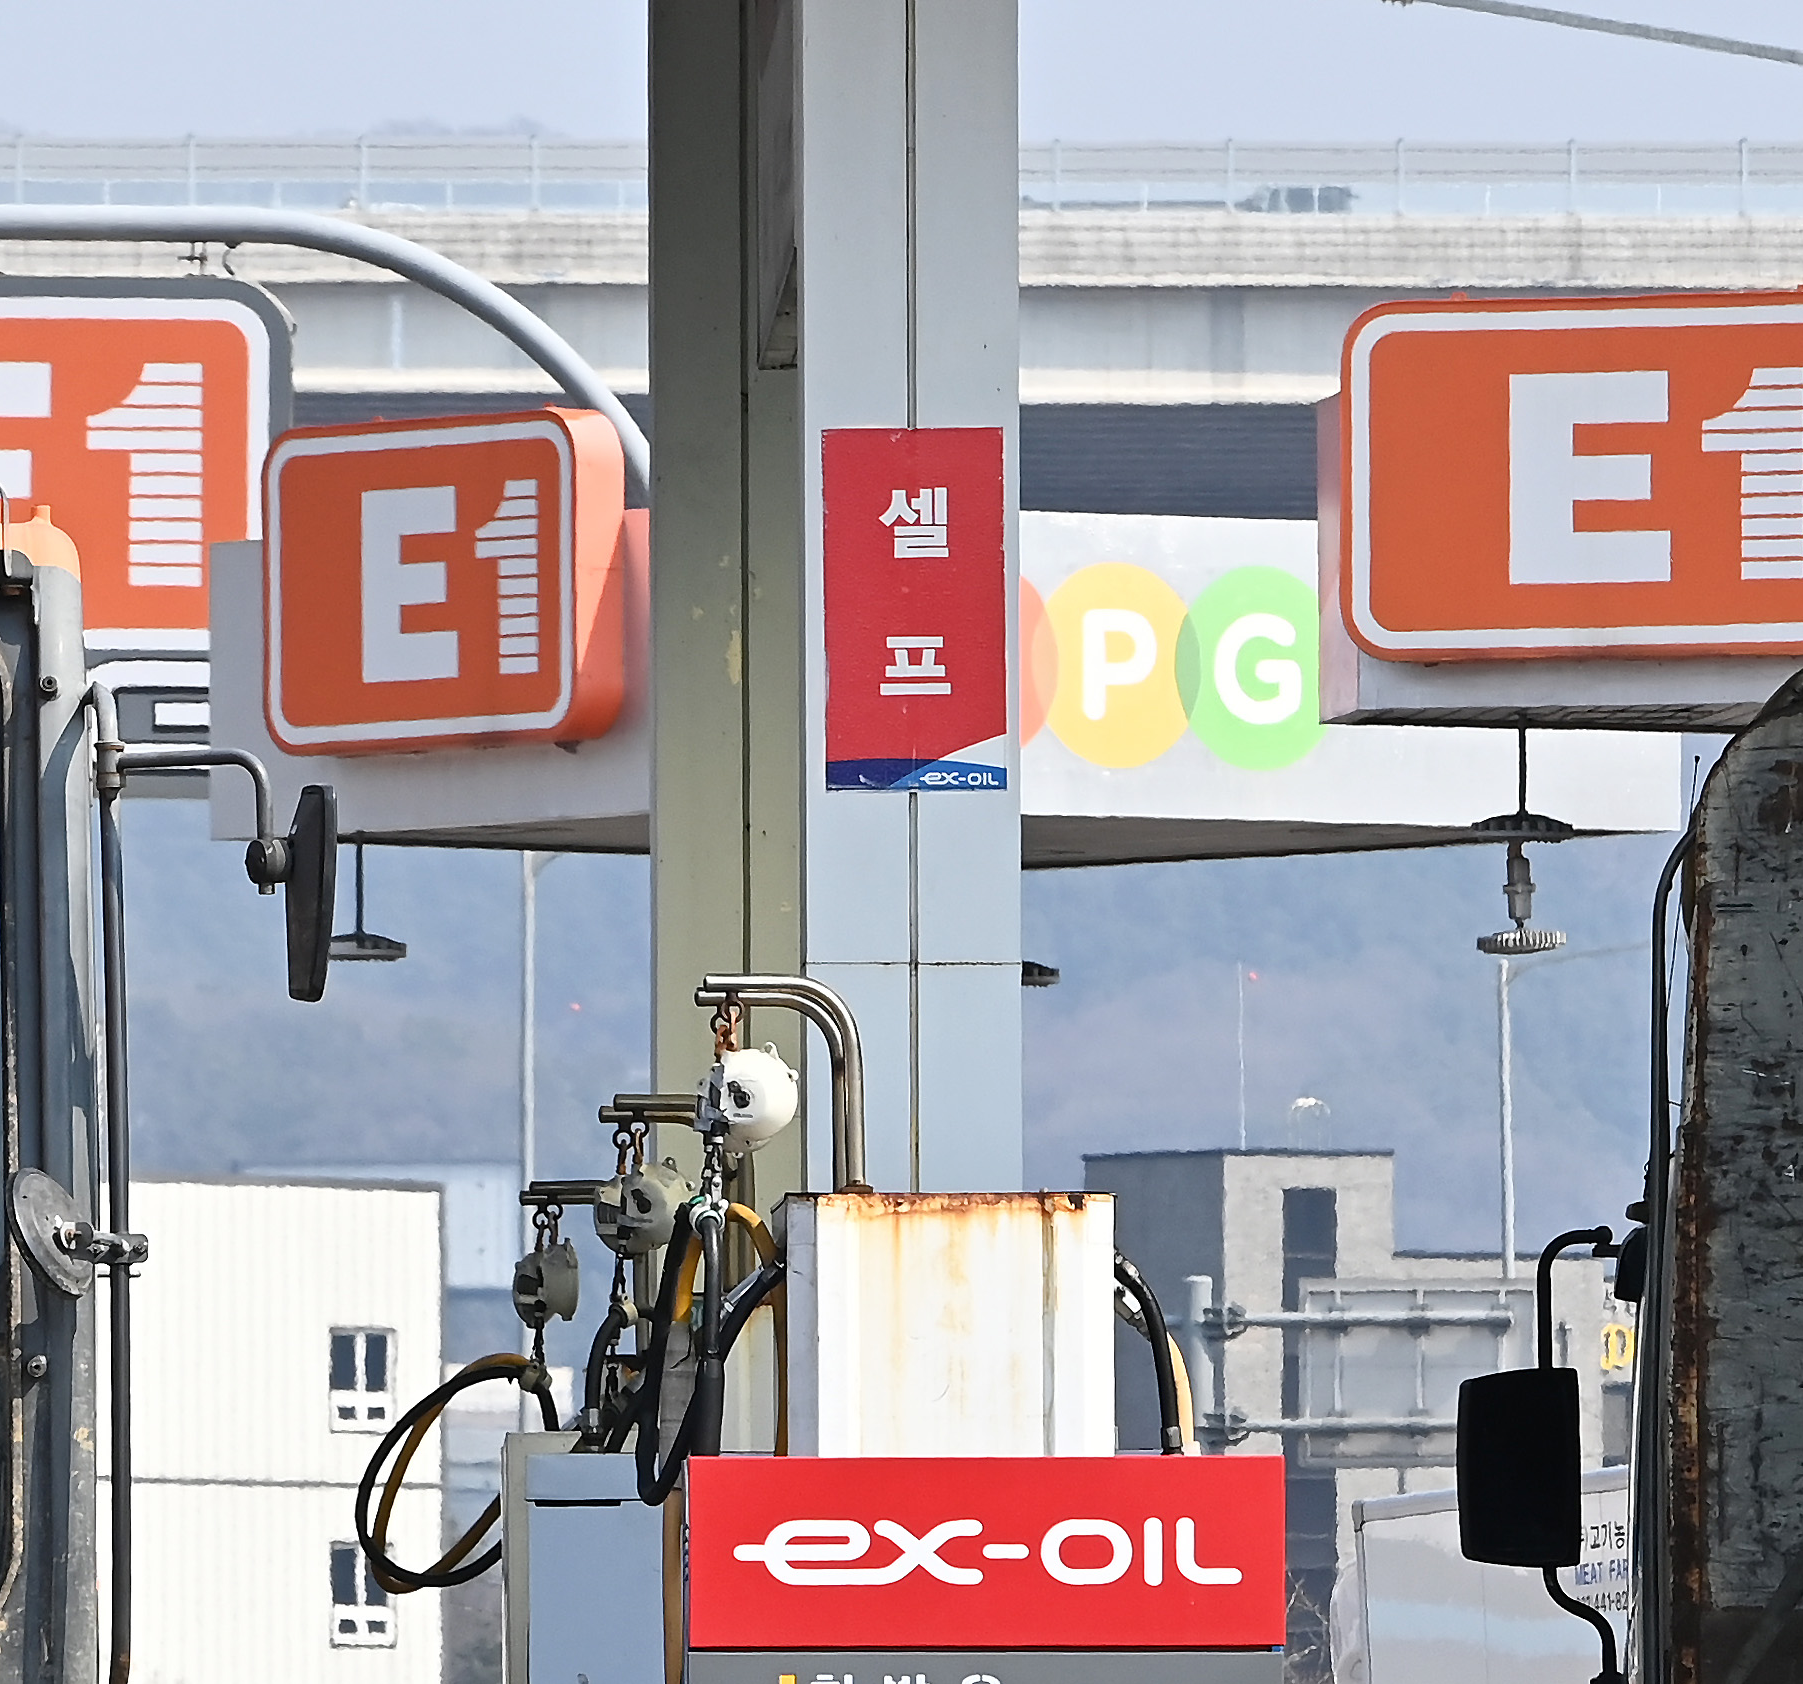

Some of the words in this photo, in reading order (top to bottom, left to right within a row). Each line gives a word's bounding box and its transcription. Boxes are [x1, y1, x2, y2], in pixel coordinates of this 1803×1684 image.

[361, 479, 538, 684] E1
[878, 486, 952, 696] 셀프
[1081, 608, 1302, 726] PG
[732, 1516, 1243, 1587] ex-OIL
